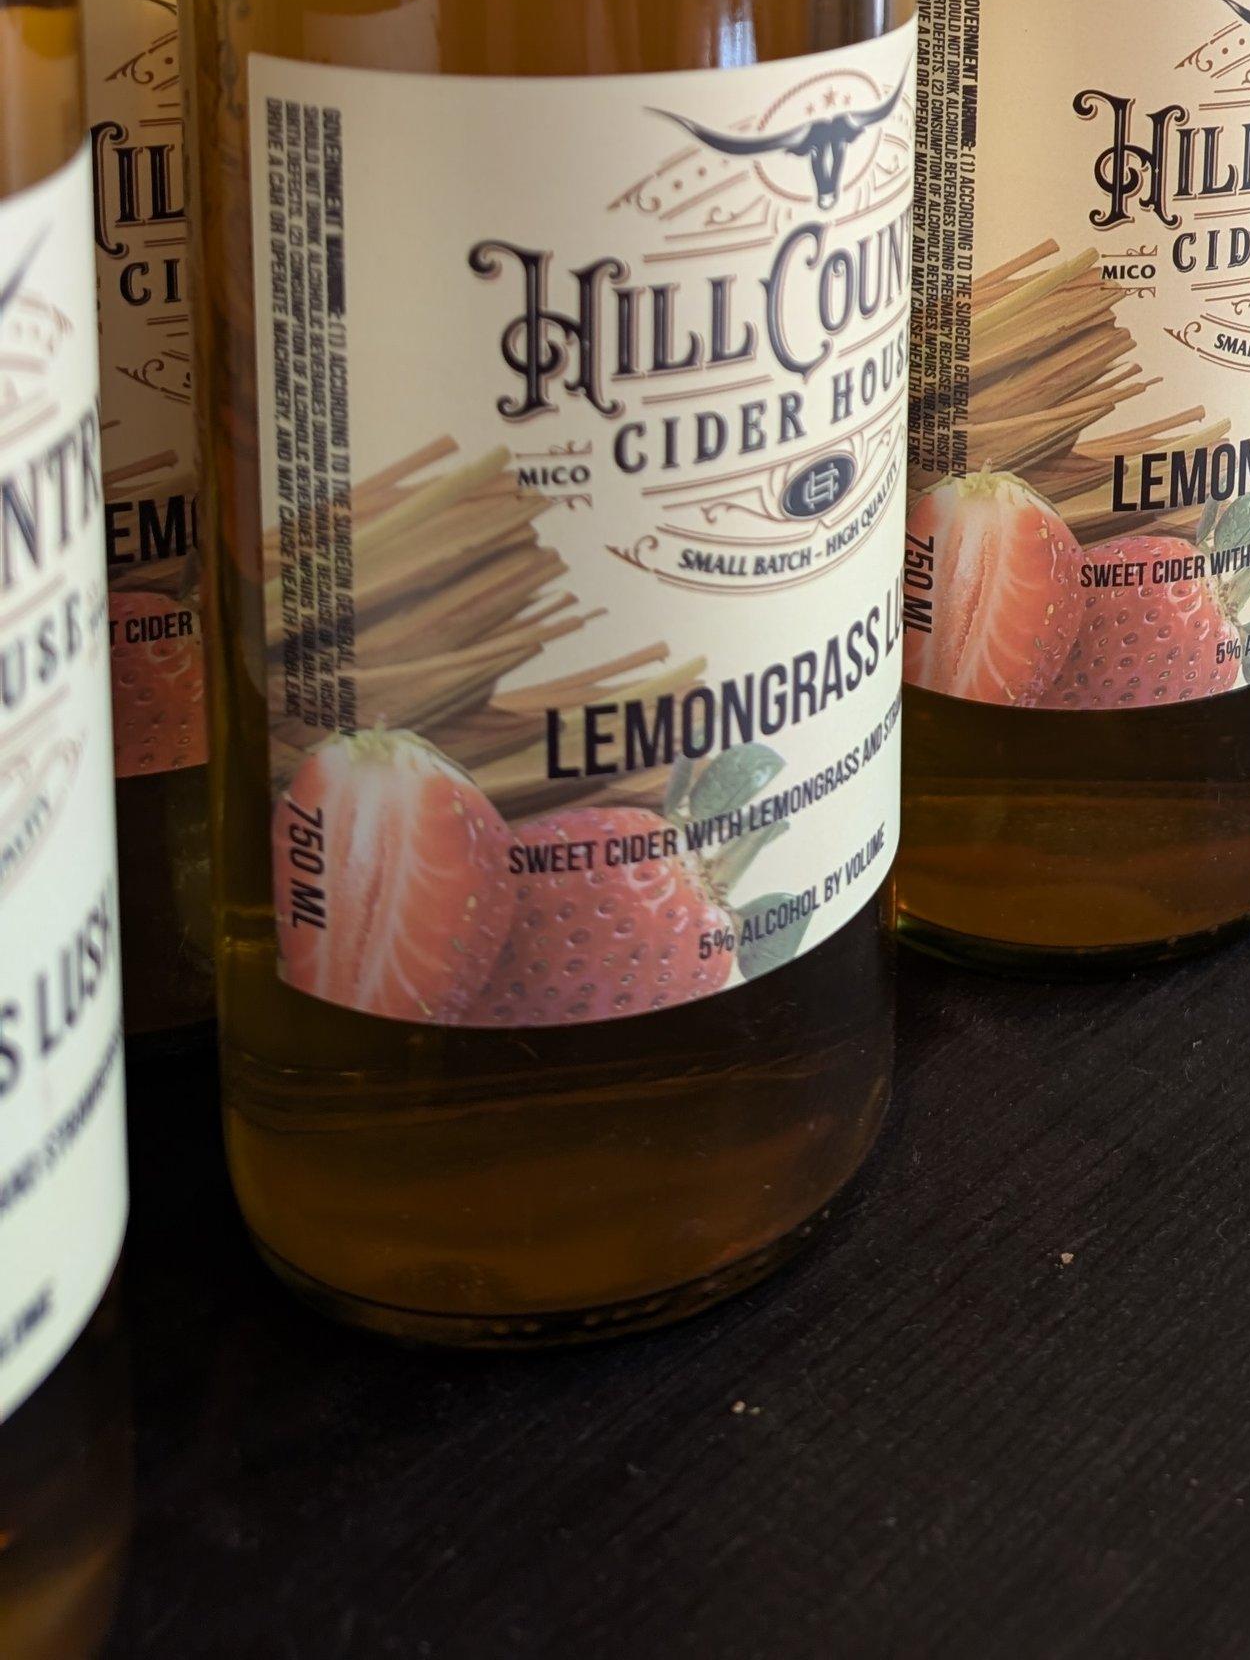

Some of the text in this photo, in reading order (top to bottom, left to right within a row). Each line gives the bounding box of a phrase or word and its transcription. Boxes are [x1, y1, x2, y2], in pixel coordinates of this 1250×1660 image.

[917, 25, 930, 34] A
[932, 22, 945, 74] DEFECTS.
[947, 35, 960, 58] NOT
[916, 40, 930, 64] CAR
[916, 68, 929, 87] OR
[931, 79, 944, 96] (2)
[946, 60, 960, 94] DRINK
[916, 90, 929, 149] OPERATE
[929, 99, 944, 179] CONSUMPTION
[944, 97, 959, 159] ALCOHOLIC
[960, 153, 976, 173] (1)
[928, 183, 942, 198] OF
[943, 161, 957, 226] BEVERAGES
[926, 200, 941, 261] ALCOHOLIC
[958, 176, 975, 250] ACCORDING
[912, 235, 925, 263] AND
[942, 229, 955, 270] DURING
[957, 254, 973, 271] TO
[1101, 263, 1156, 279] MICO
[911, 266, 924, 294] MAY
[925, 265, 939, 330] BEVERAGES
[956, 274, 973, 298] THE
[468, 206, 909, 422] HILL COUN
[910, 297, 923, 339] CAUSE
[939, 272, 954, 339] PREGNANCY
[329, 322, 347, 348] (1)
[954, 301, 971, 361] SURGEON
[909, 342, 922, 390] HEALTH
[924, 332, 938, 377] IMPAIRS
[938, 342, 953, 390] BECAUSE
[267, 99, 300, 718] DRIVE A CAR OR OPERATE MACHINERY, AND MAY CAUSE HEALTH PROBLEMS.
[329, 353, 348, 448] ACCORDING
[613, 324, 908, 475] CIDER HOUS
[923, 381, 936, 410] YOUR
[938, 393, 951, 408] OF
[951, 364, 970, 424] GENERAL,
[923, 412, 935, 456] ABILITY
[937, 410, 951, 430] THE
[331, 454, 348, 473] TO
[922, 459, 935, 471] TO
[937, 433, 950, 456] RISK
[951, 430, 968, 479] WOMEN
[516, 465, 591, 488] MICO
[936, 461, 949, 476] OF
[333, 479, 349, 507] THE
[334, 515, 353, 590] SURGEON
[678, 548, 746, 576] SMALL
[753, 547, 811, 575] BATCH
[826, 522, 859, 556] HIGH
[1080, 564, 1146, 588] SWEET
[1152, 555, 1205, 583] CIDER
[1210, 545, 1249, 575] WITH
[904, 536, 934, 634] 750 ML
[125, 610, 193, 644] CIDER
[336, 594, 354, 672] GENERAL,
[1216, 639, 1240, 664] 5%
[338, 676, 356, 738] WOMEN
[545, 605, 880, 779] LEMONGRASS
[508, 728, 883, 875] SWEET CIDER WITH LEMONGRASS AND
[285, 805, 325, 930] 750 ML
[700, 820, 886, 960] 5% ALCOHOL BY VOLUME
